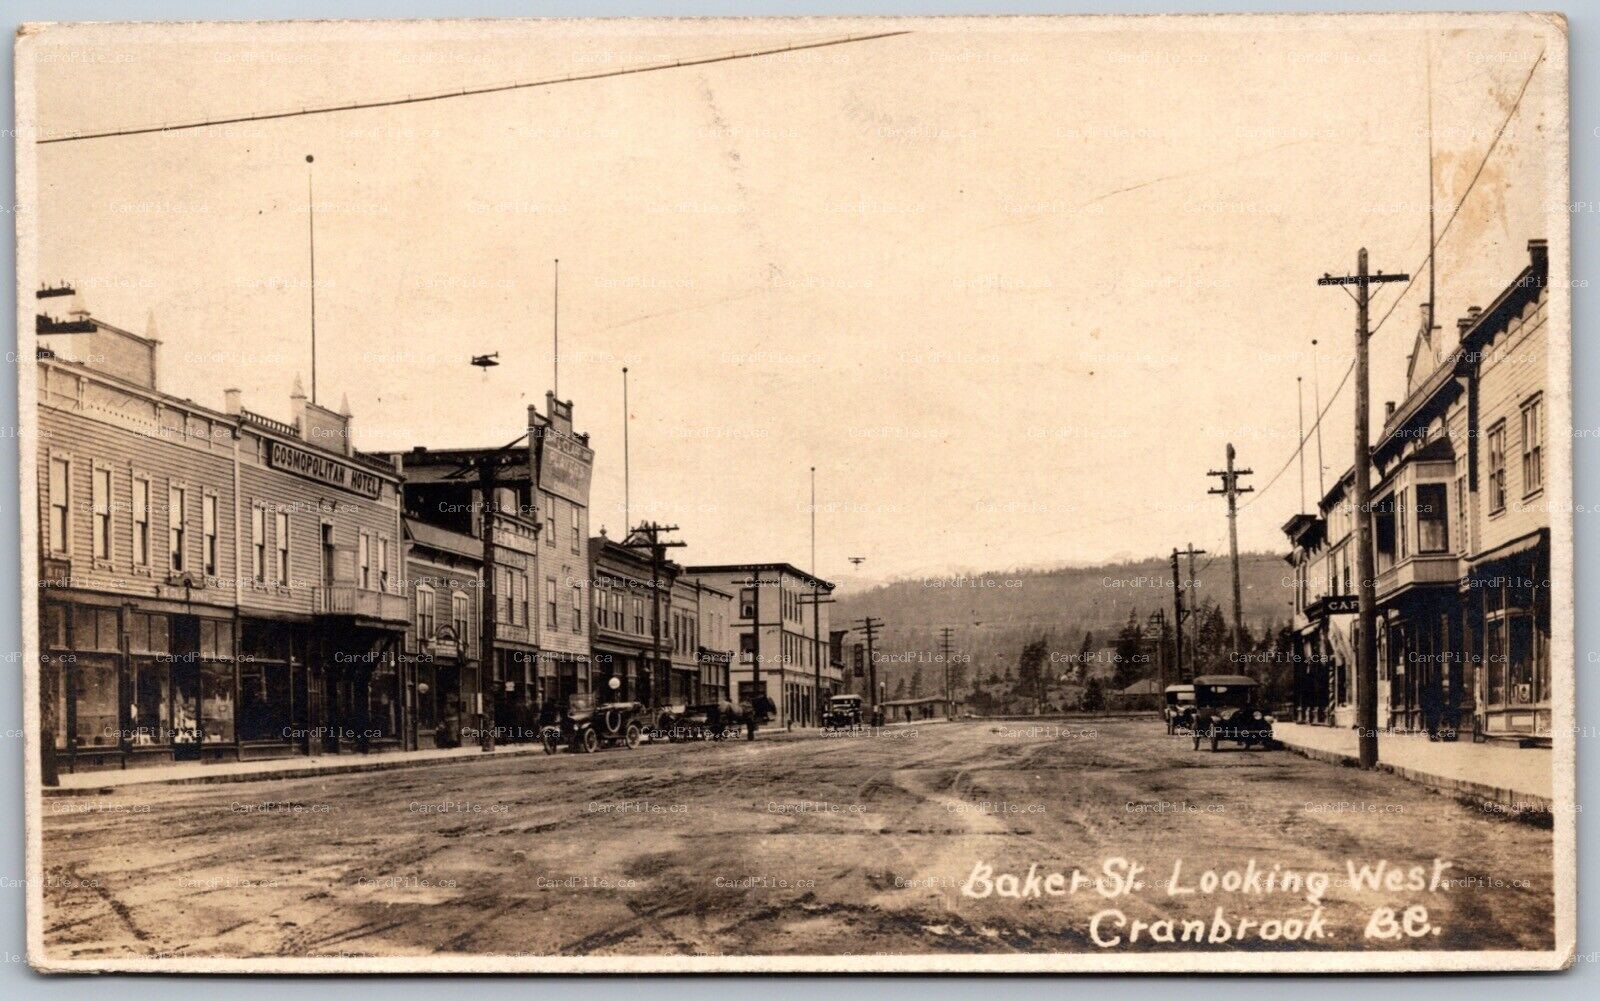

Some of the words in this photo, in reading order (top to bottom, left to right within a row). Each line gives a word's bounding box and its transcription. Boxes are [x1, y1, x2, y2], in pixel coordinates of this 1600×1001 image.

[274, 445, 345, 484] COSMOPOLITAN
[351, 470, 377, 495] HOTEL
[1328, 600, 1360, 611] CAF
